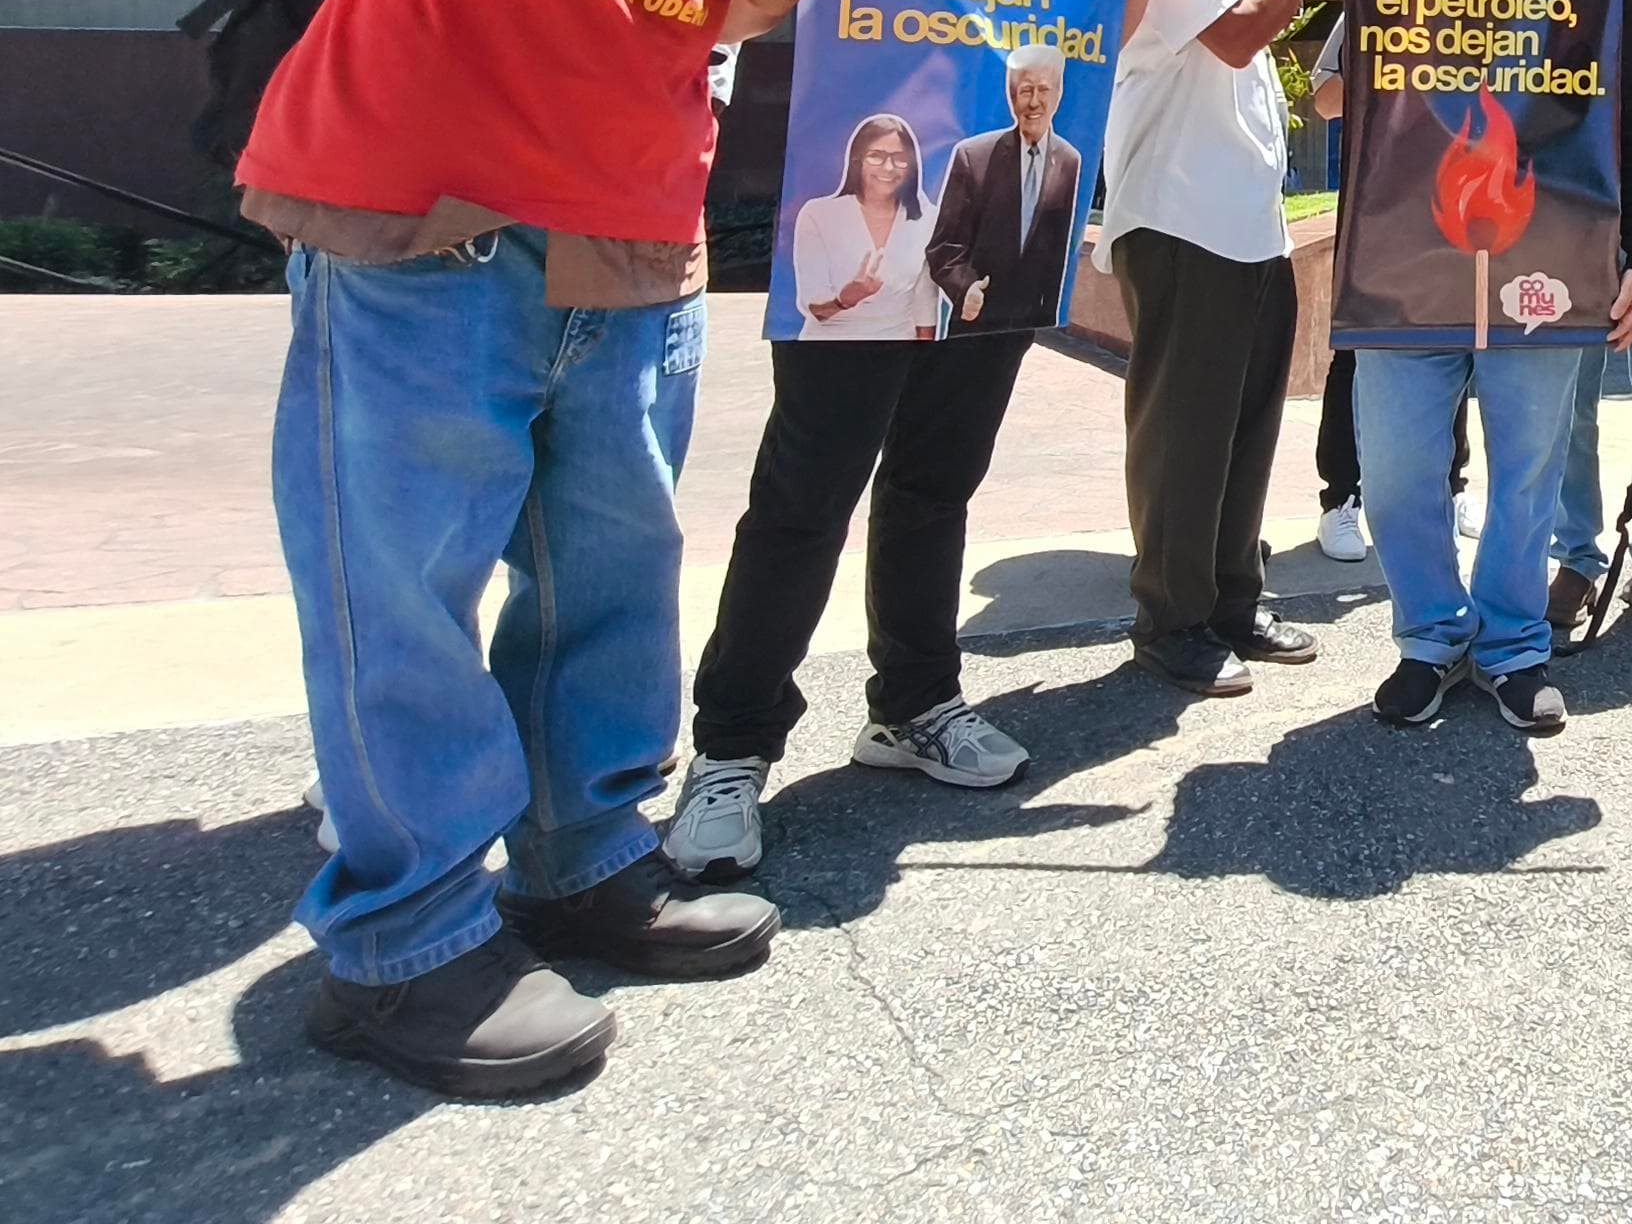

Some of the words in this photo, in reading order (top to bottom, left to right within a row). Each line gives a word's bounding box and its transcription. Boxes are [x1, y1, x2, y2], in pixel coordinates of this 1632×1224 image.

[893, 9, 1107, 64] oscuridad.
[1360, 24, 1430, 54] nos
[1435, 20, 1539, 64] dejan
[1374, 55, 1405, 90] la
[1412, 60, 1605, 96] oscuridad.
[1518, 304, 1556, 317] nes
